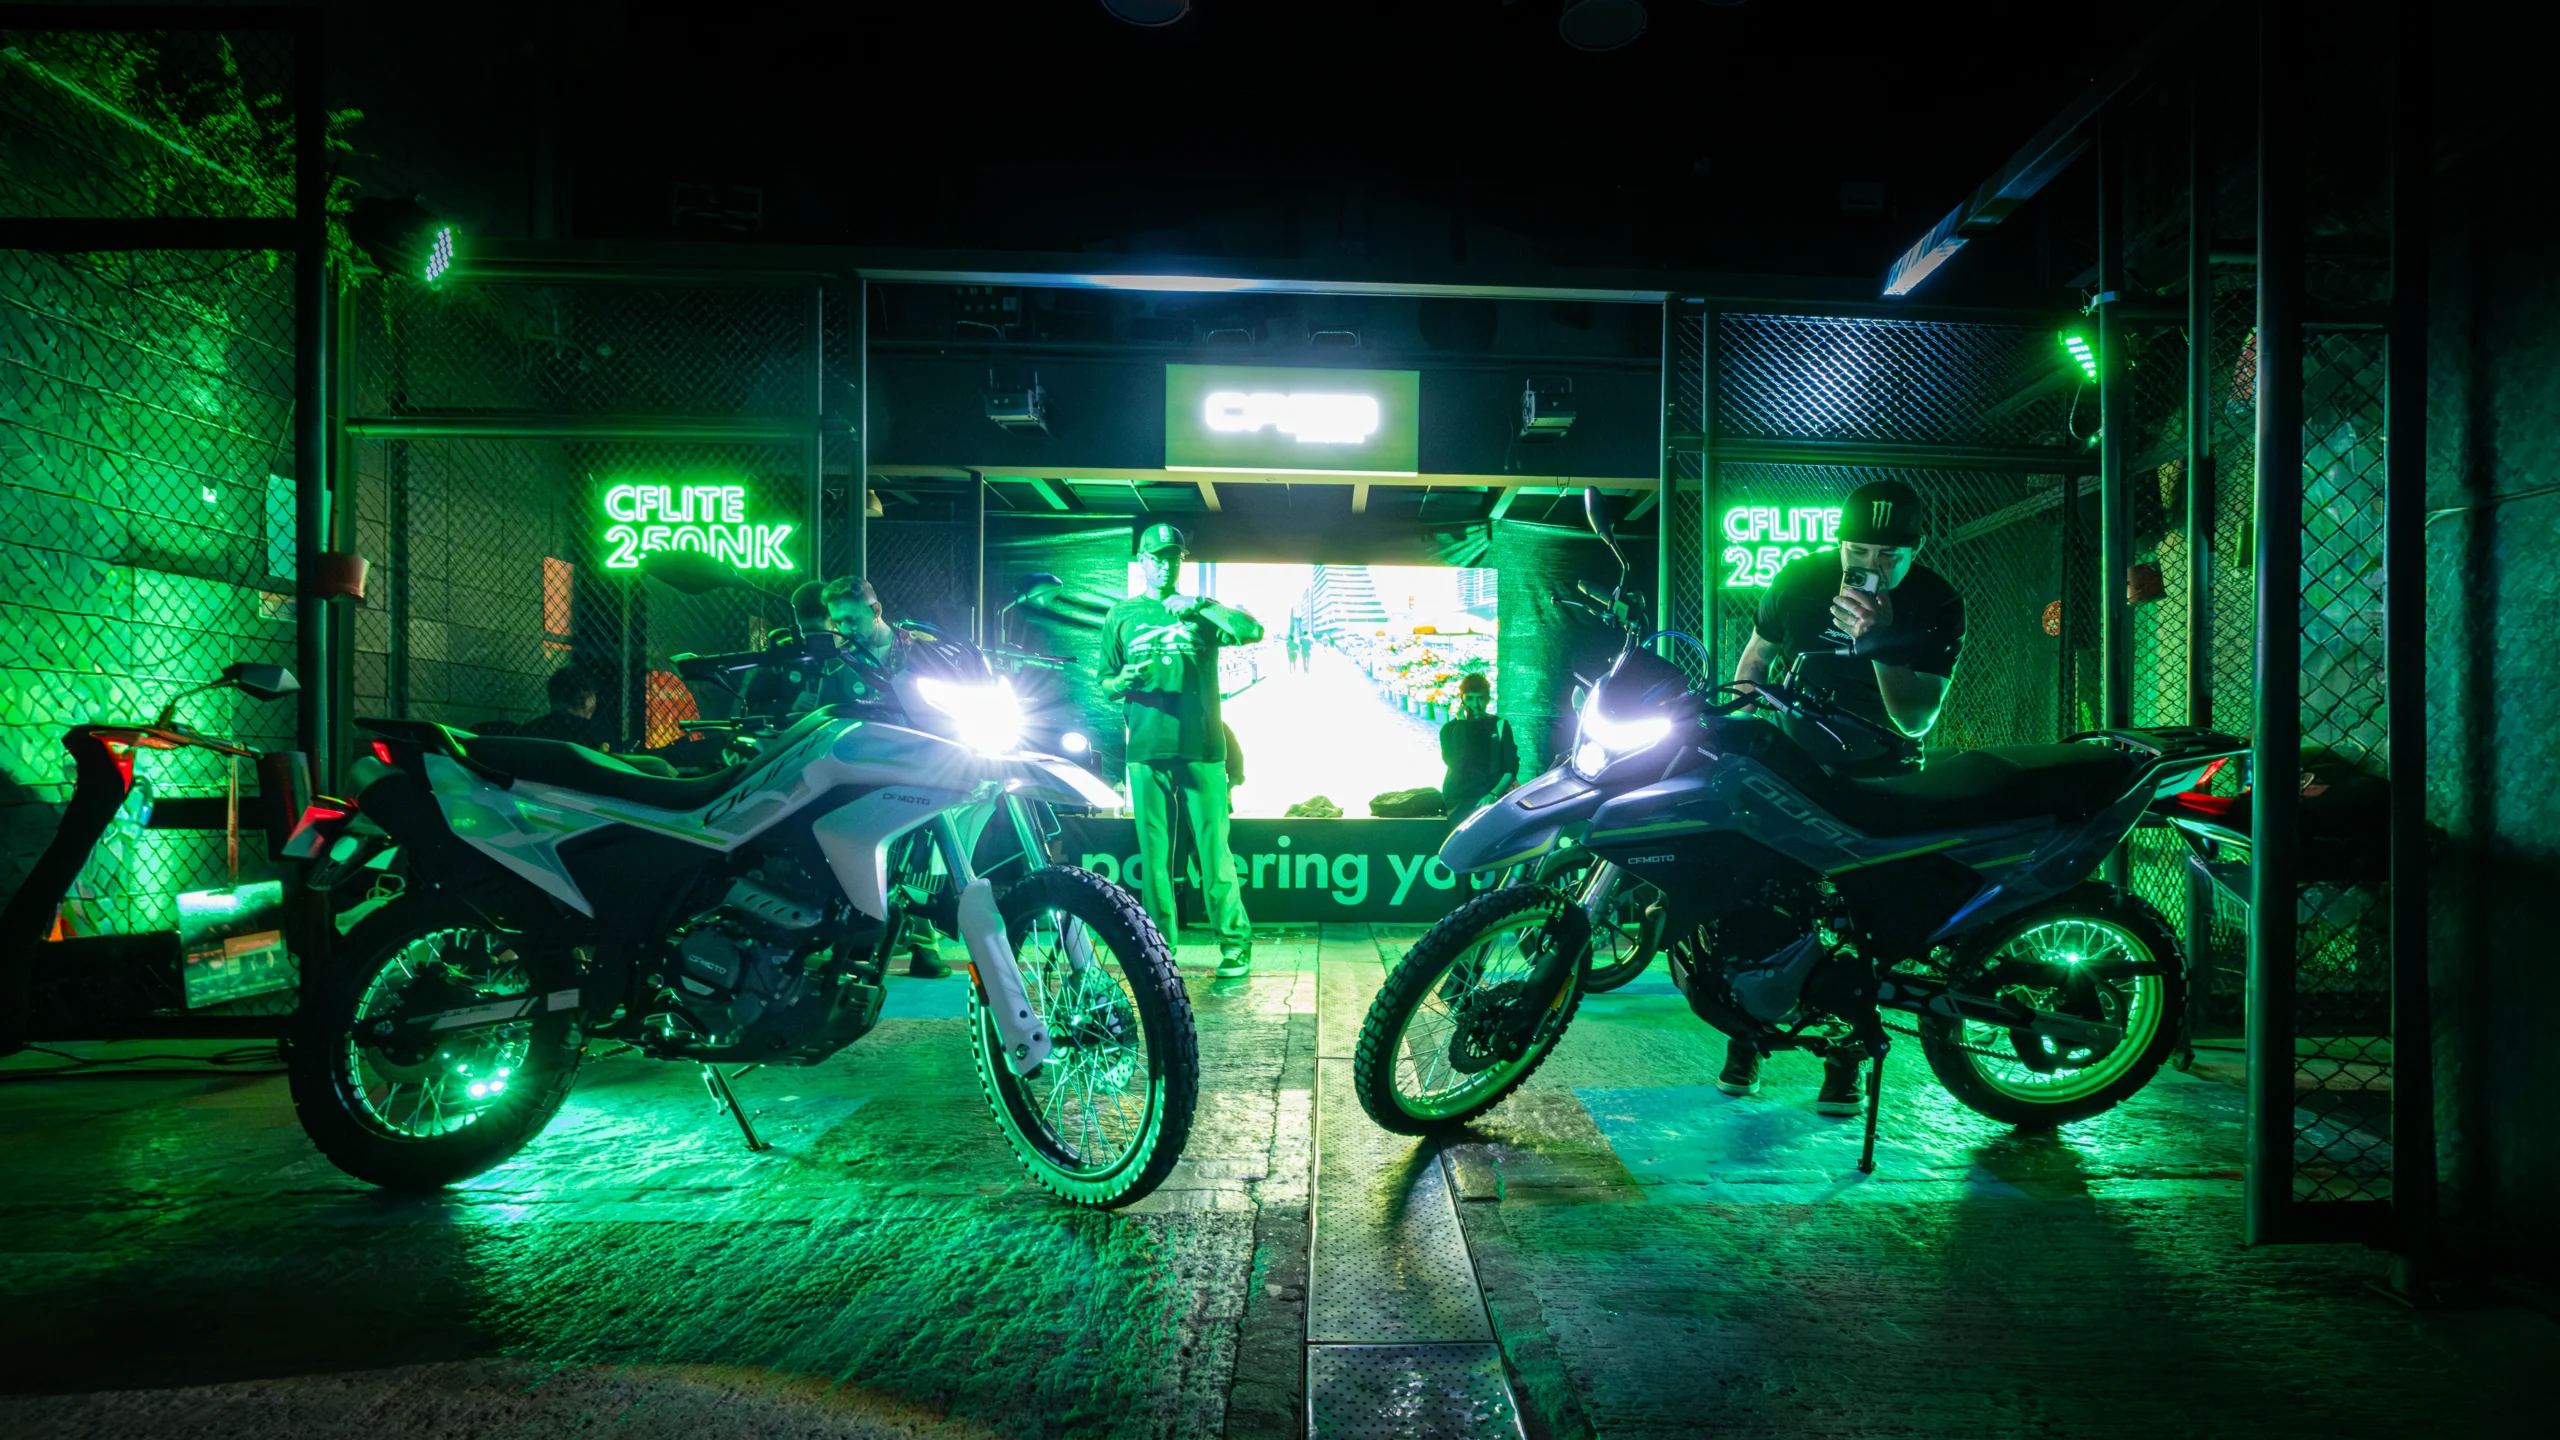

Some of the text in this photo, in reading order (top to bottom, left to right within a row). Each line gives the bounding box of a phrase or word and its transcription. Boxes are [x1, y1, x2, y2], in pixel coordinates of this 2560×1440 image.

[604, 485, 746, 523] CFLITE
[1724, 507, 1842, 542] CFLITE
[604, 525, 795, 570] 250NK
[882, 792, 931, 806] CFMOTO
[1742, 775, 1861, 859] DUAL
[1627, 854, 1675, 865] CFMOTO
